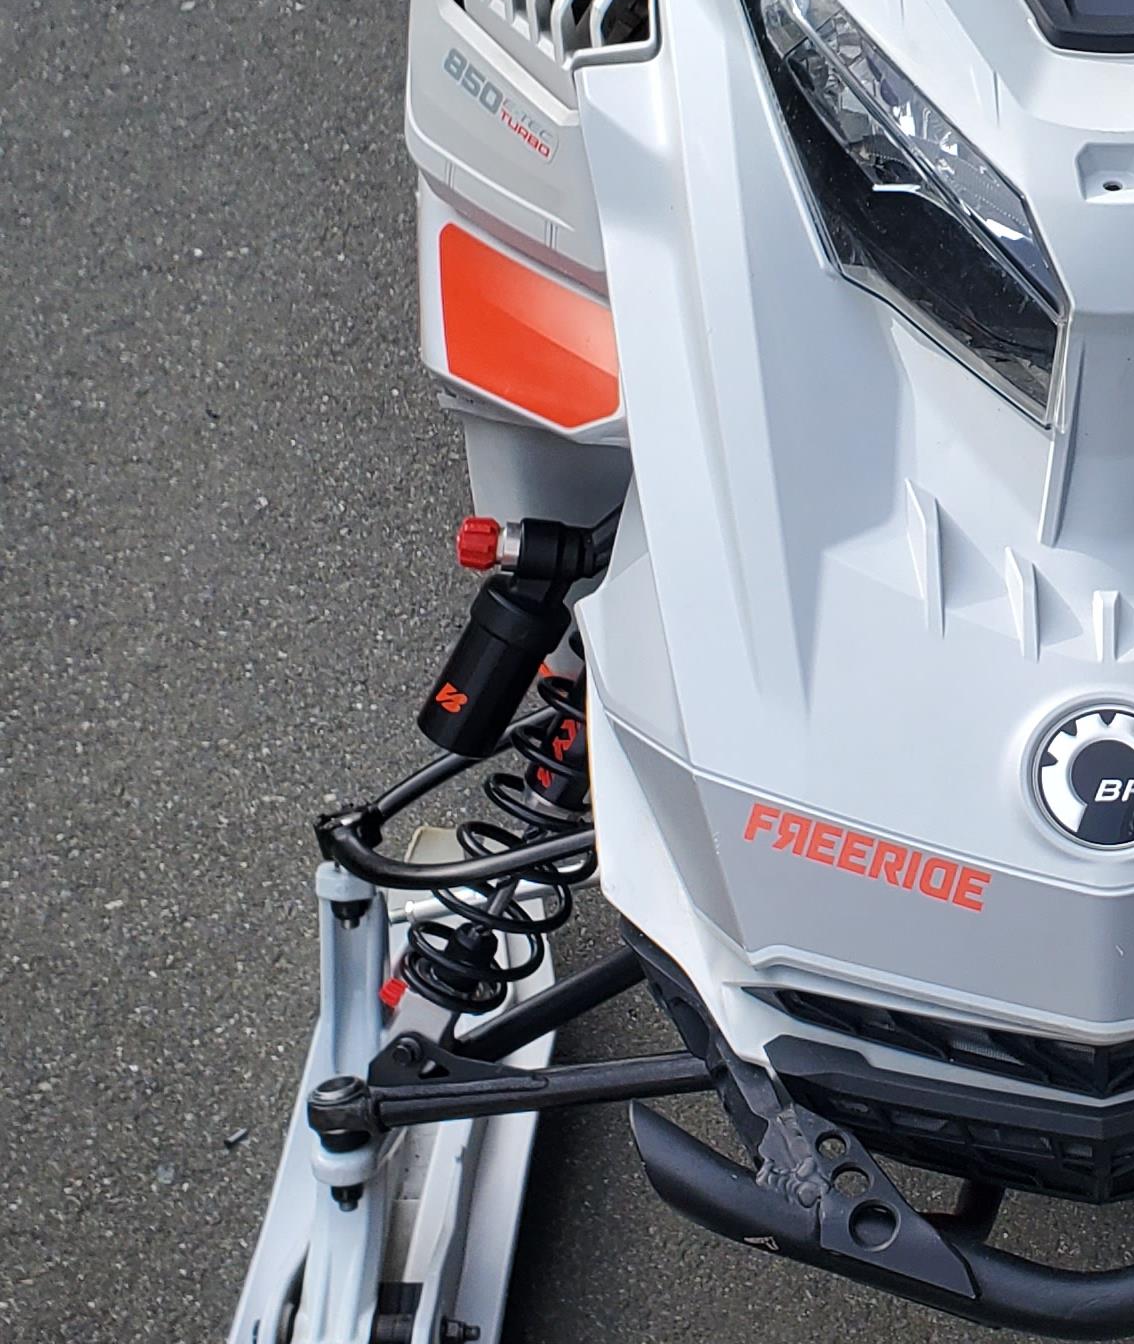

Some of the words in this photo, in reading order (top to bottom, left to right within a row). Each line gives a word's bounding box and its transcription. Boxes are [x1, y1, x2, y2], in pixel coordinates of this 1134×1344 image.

[443, 47, 504, 115] 850
[499, 109, 551, 159] TURBO
[743, 802, 992, 913] FREERIDE
